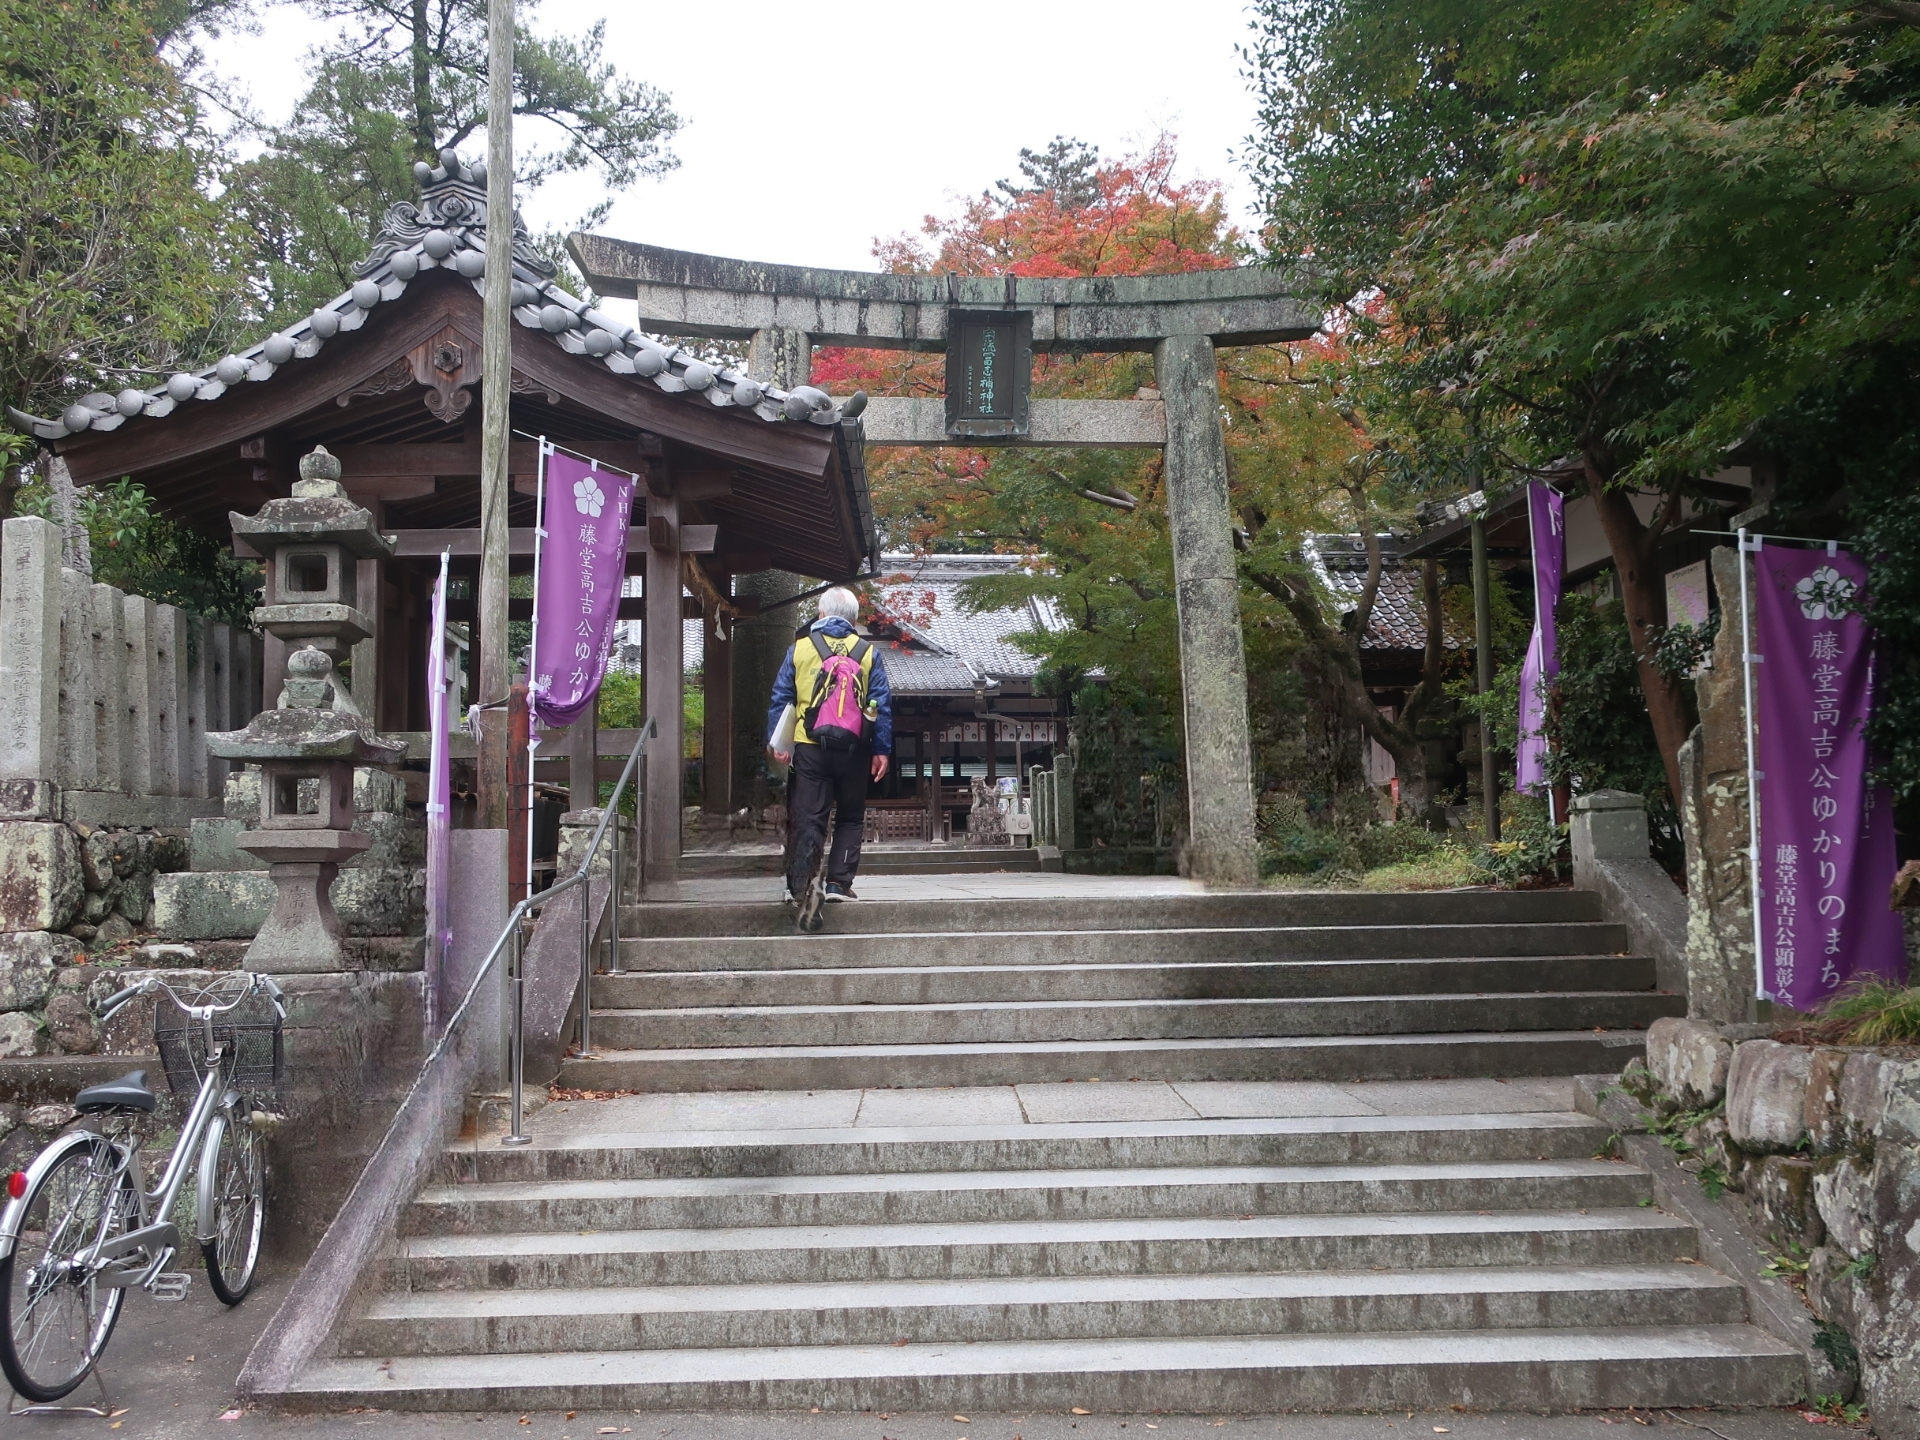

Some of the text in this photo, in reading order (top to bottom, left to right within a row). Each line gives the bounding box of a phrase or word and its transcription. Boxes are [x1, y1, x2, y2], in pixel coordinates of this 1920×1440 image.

[1809, 630, 1846, 989] 藤堂高吉公ゆかりのまち
